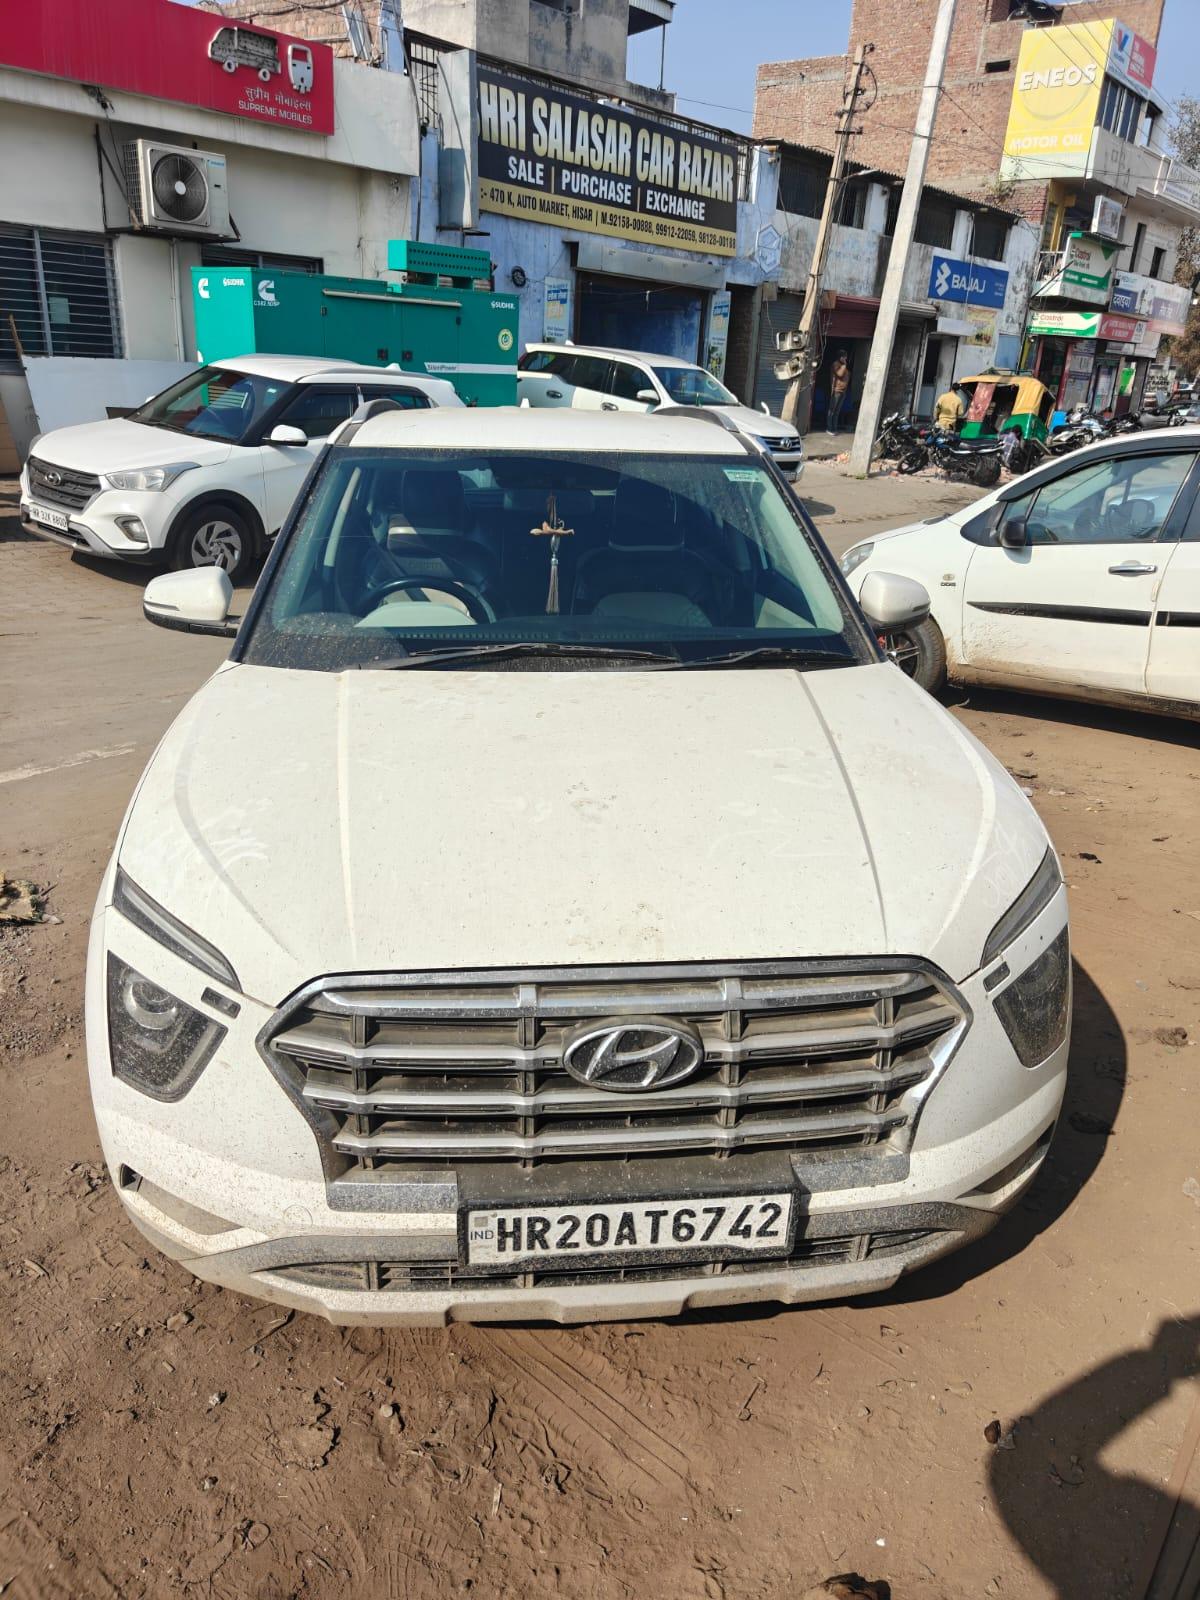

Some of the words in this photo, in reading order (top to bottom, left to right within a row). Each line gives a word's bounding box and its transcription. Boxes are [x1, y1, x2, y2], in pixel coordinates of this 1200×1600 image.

[1018, 64, 1097, 91] ENEOS
[239, 100, 277, 117] SUPREME
[279, 109, 312, 125] MOBILES
[477, 81, 526, 152] HRI
[532, 97, 632, 178] SALASAR
[636, 128, 675, 188] CAR
[678, 141, 734, 203] BAZAR
[1009, 135, 1058, 151] MOTOR
[1062, 133, 1083, 146] OIL
[508, 155, 544, 185] SALE
[561, 169, 632, 205] PURCHASE
[645, 189, 706, 221] EXCHANGE
[490, 187, 504, 203] 470
[507, 191, 515, 209] K,
[517, 193, 537, 211] AUTO
[539, 198, 570, 220] MARKET,
[571, 205, 593, 222] HISAR
[951, 273, 986, 293] BAJAJ
[470, 1229, 494, 1241] IND
[497, 1202, 783, 1252] HR20AT6742
